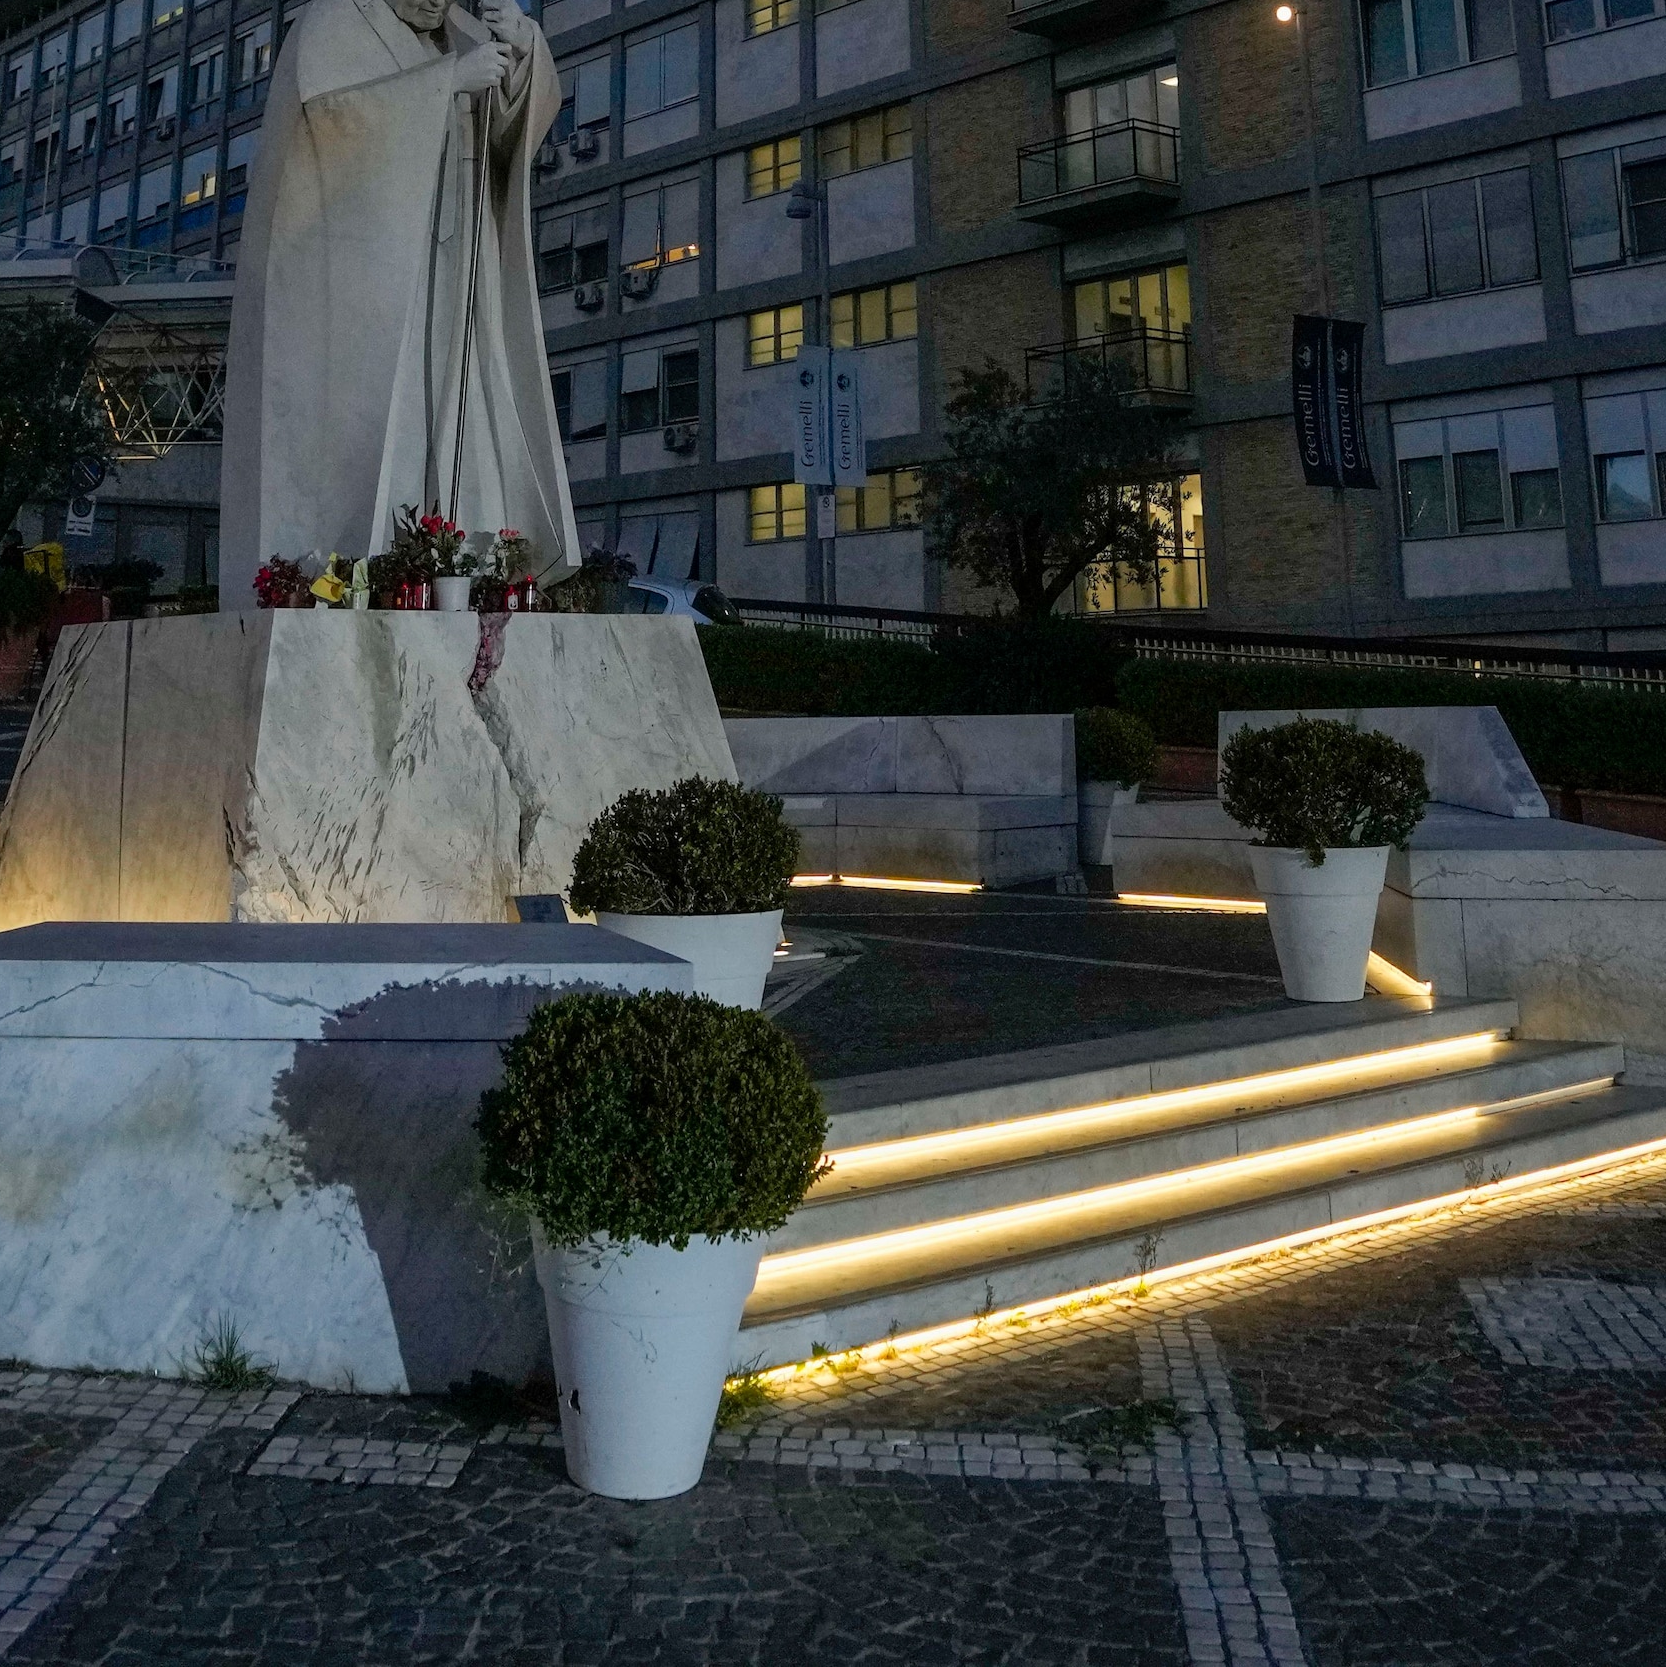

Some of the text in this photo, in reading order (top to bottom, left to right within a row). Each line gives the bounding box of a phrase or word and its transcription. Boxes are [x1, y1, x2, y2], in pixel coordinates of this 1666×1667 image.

[799, 401, 815, 468] Gemelli
[837, 404, 852, 470] Gemelli
[1298, 383, 1321, 467] Gemelli
[1336, 387, 1357, 470] Gemelli
